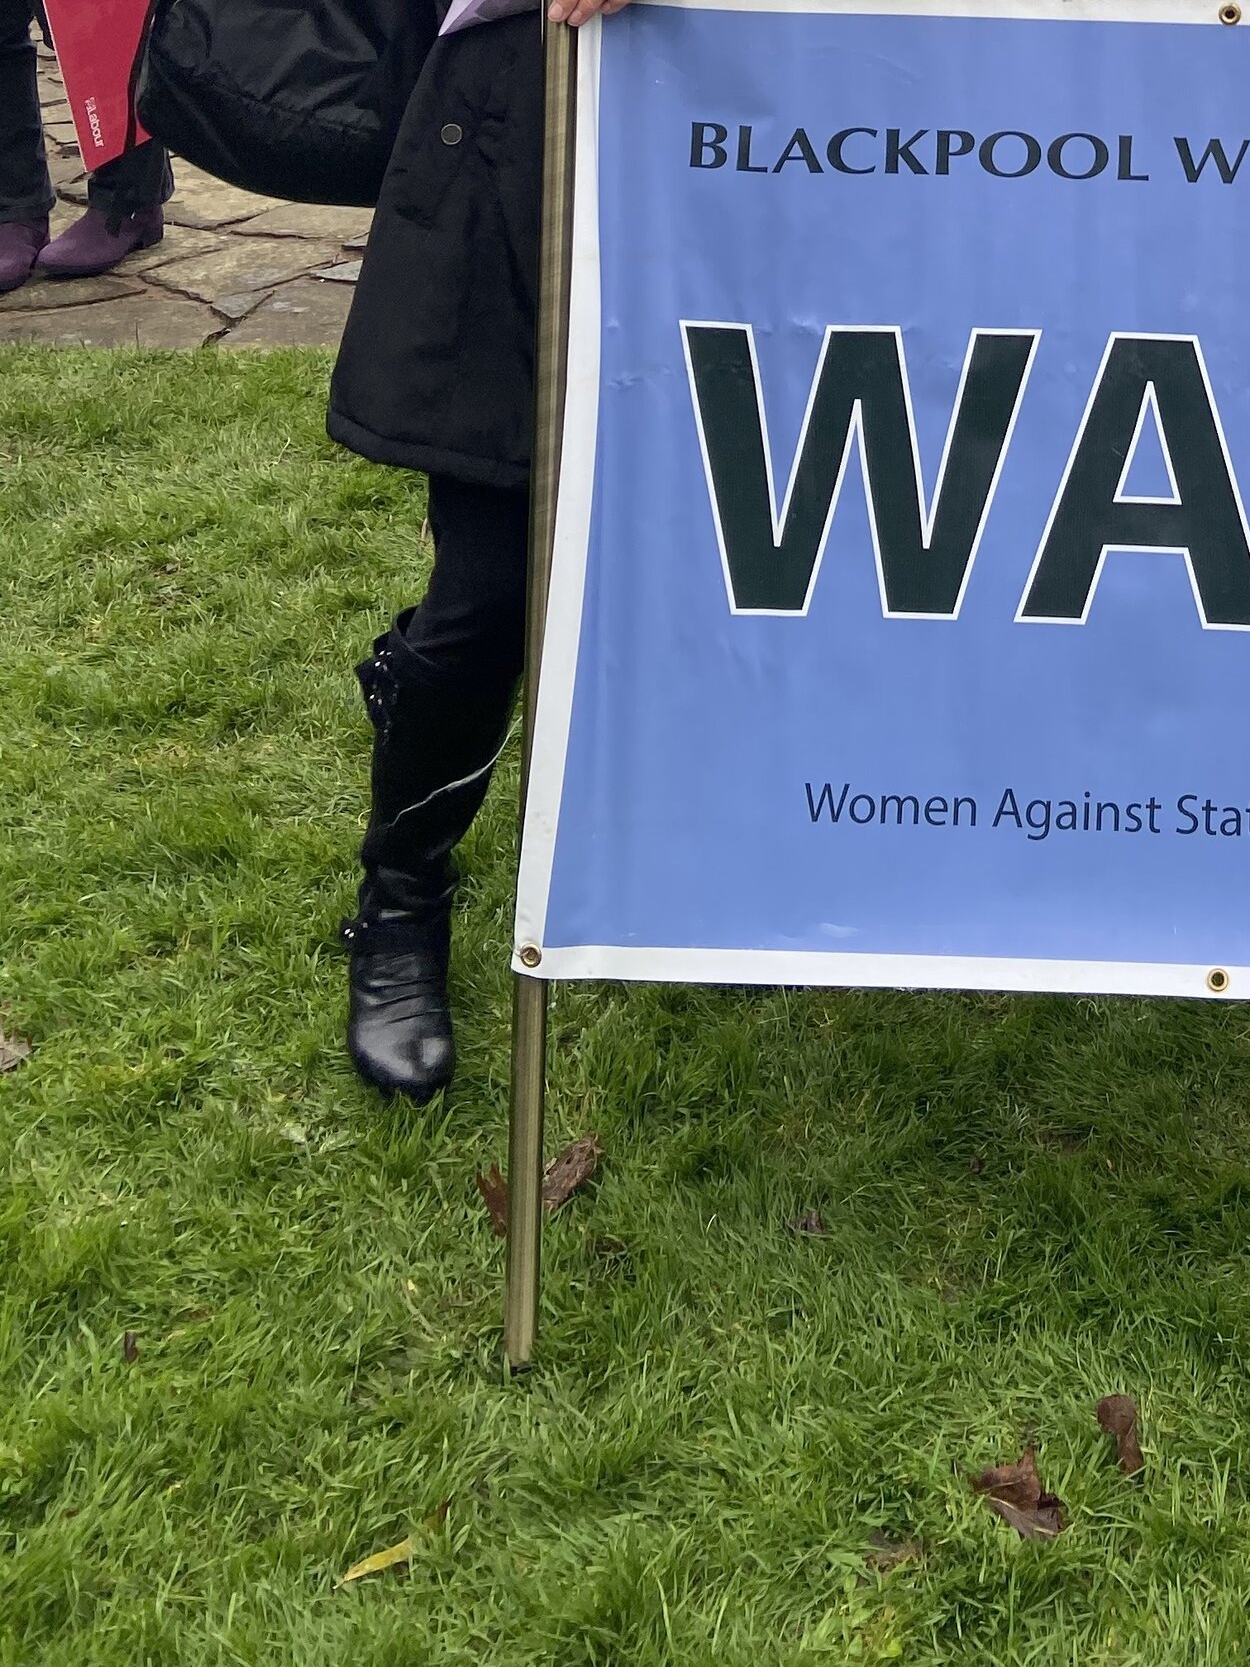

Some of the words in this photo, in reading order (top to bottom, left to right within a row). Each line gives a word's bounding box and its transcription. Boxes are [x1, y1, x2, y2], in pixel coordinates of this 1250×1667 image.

[86, 106, 103, 147] Labour
[689, 121, 1149, 181] BLACKPOOL
[805, 782, 977, 827] Women
[992, 788, 1162, 840] Against
